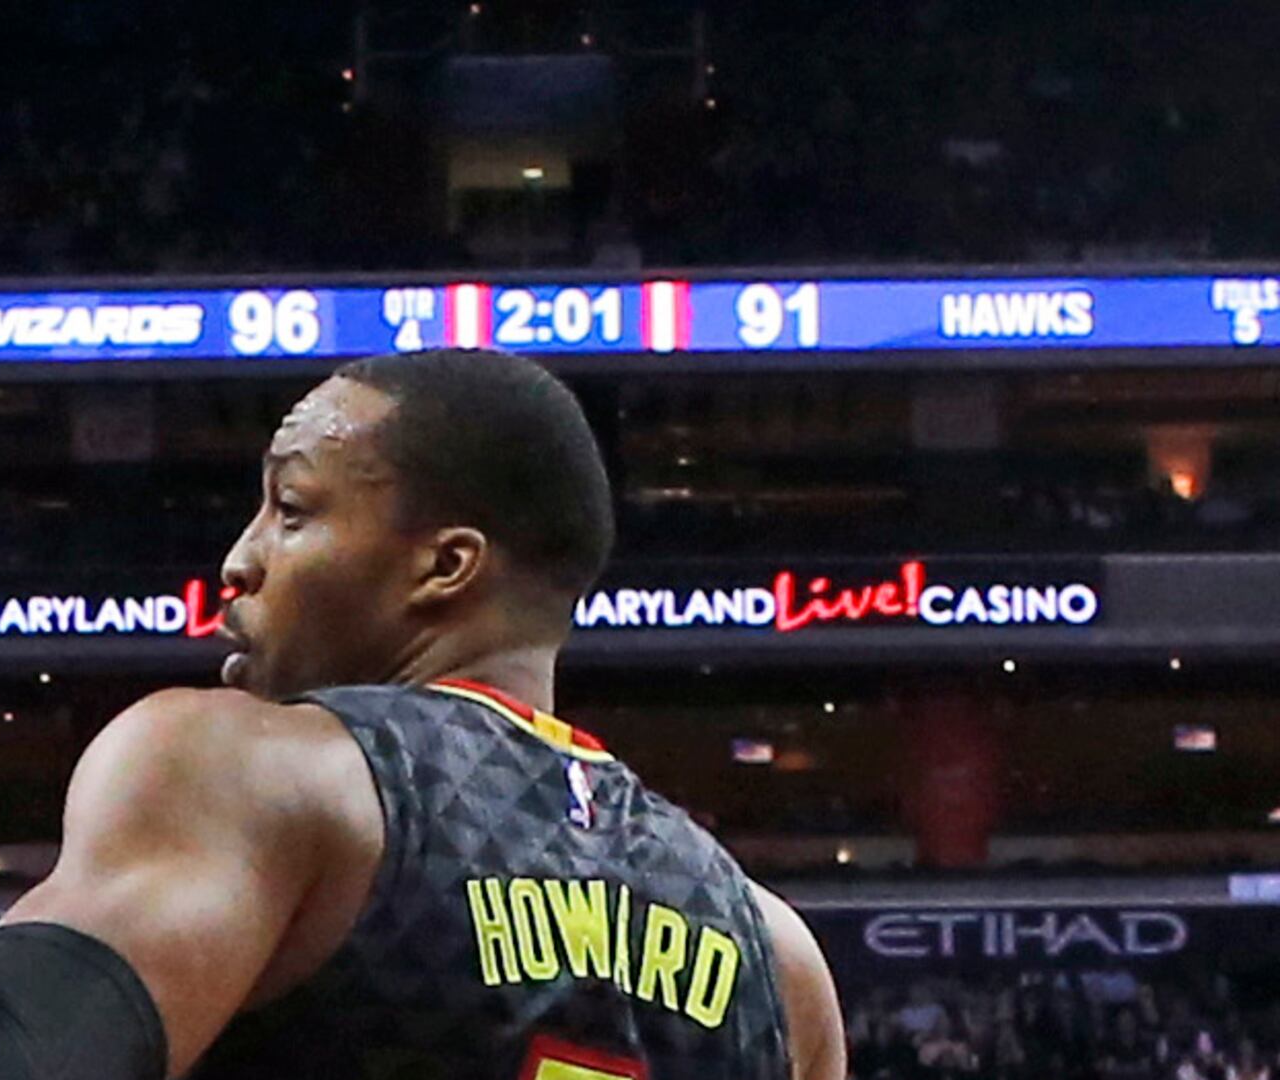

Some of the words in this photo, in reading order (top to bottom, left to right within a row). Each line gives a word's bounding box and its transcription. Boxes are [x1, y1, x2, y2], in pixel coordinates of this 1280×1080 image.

[228, 289, 321, 355] 96
[393, 319, 423, 351] 4
[495, 288, 621, 343] 2:01
[736, 283, 820, 348] 91
[942, 291, 1094, 337] HAWKS
[1233, 308, 1261, 344] 5
[773, 560, 926, 632] Live!
[919, 583, 1098, 625] CASINO
[465, 876, 740, 1029] HOWARD
[864, 910, 1189, 958] ETIHAD
